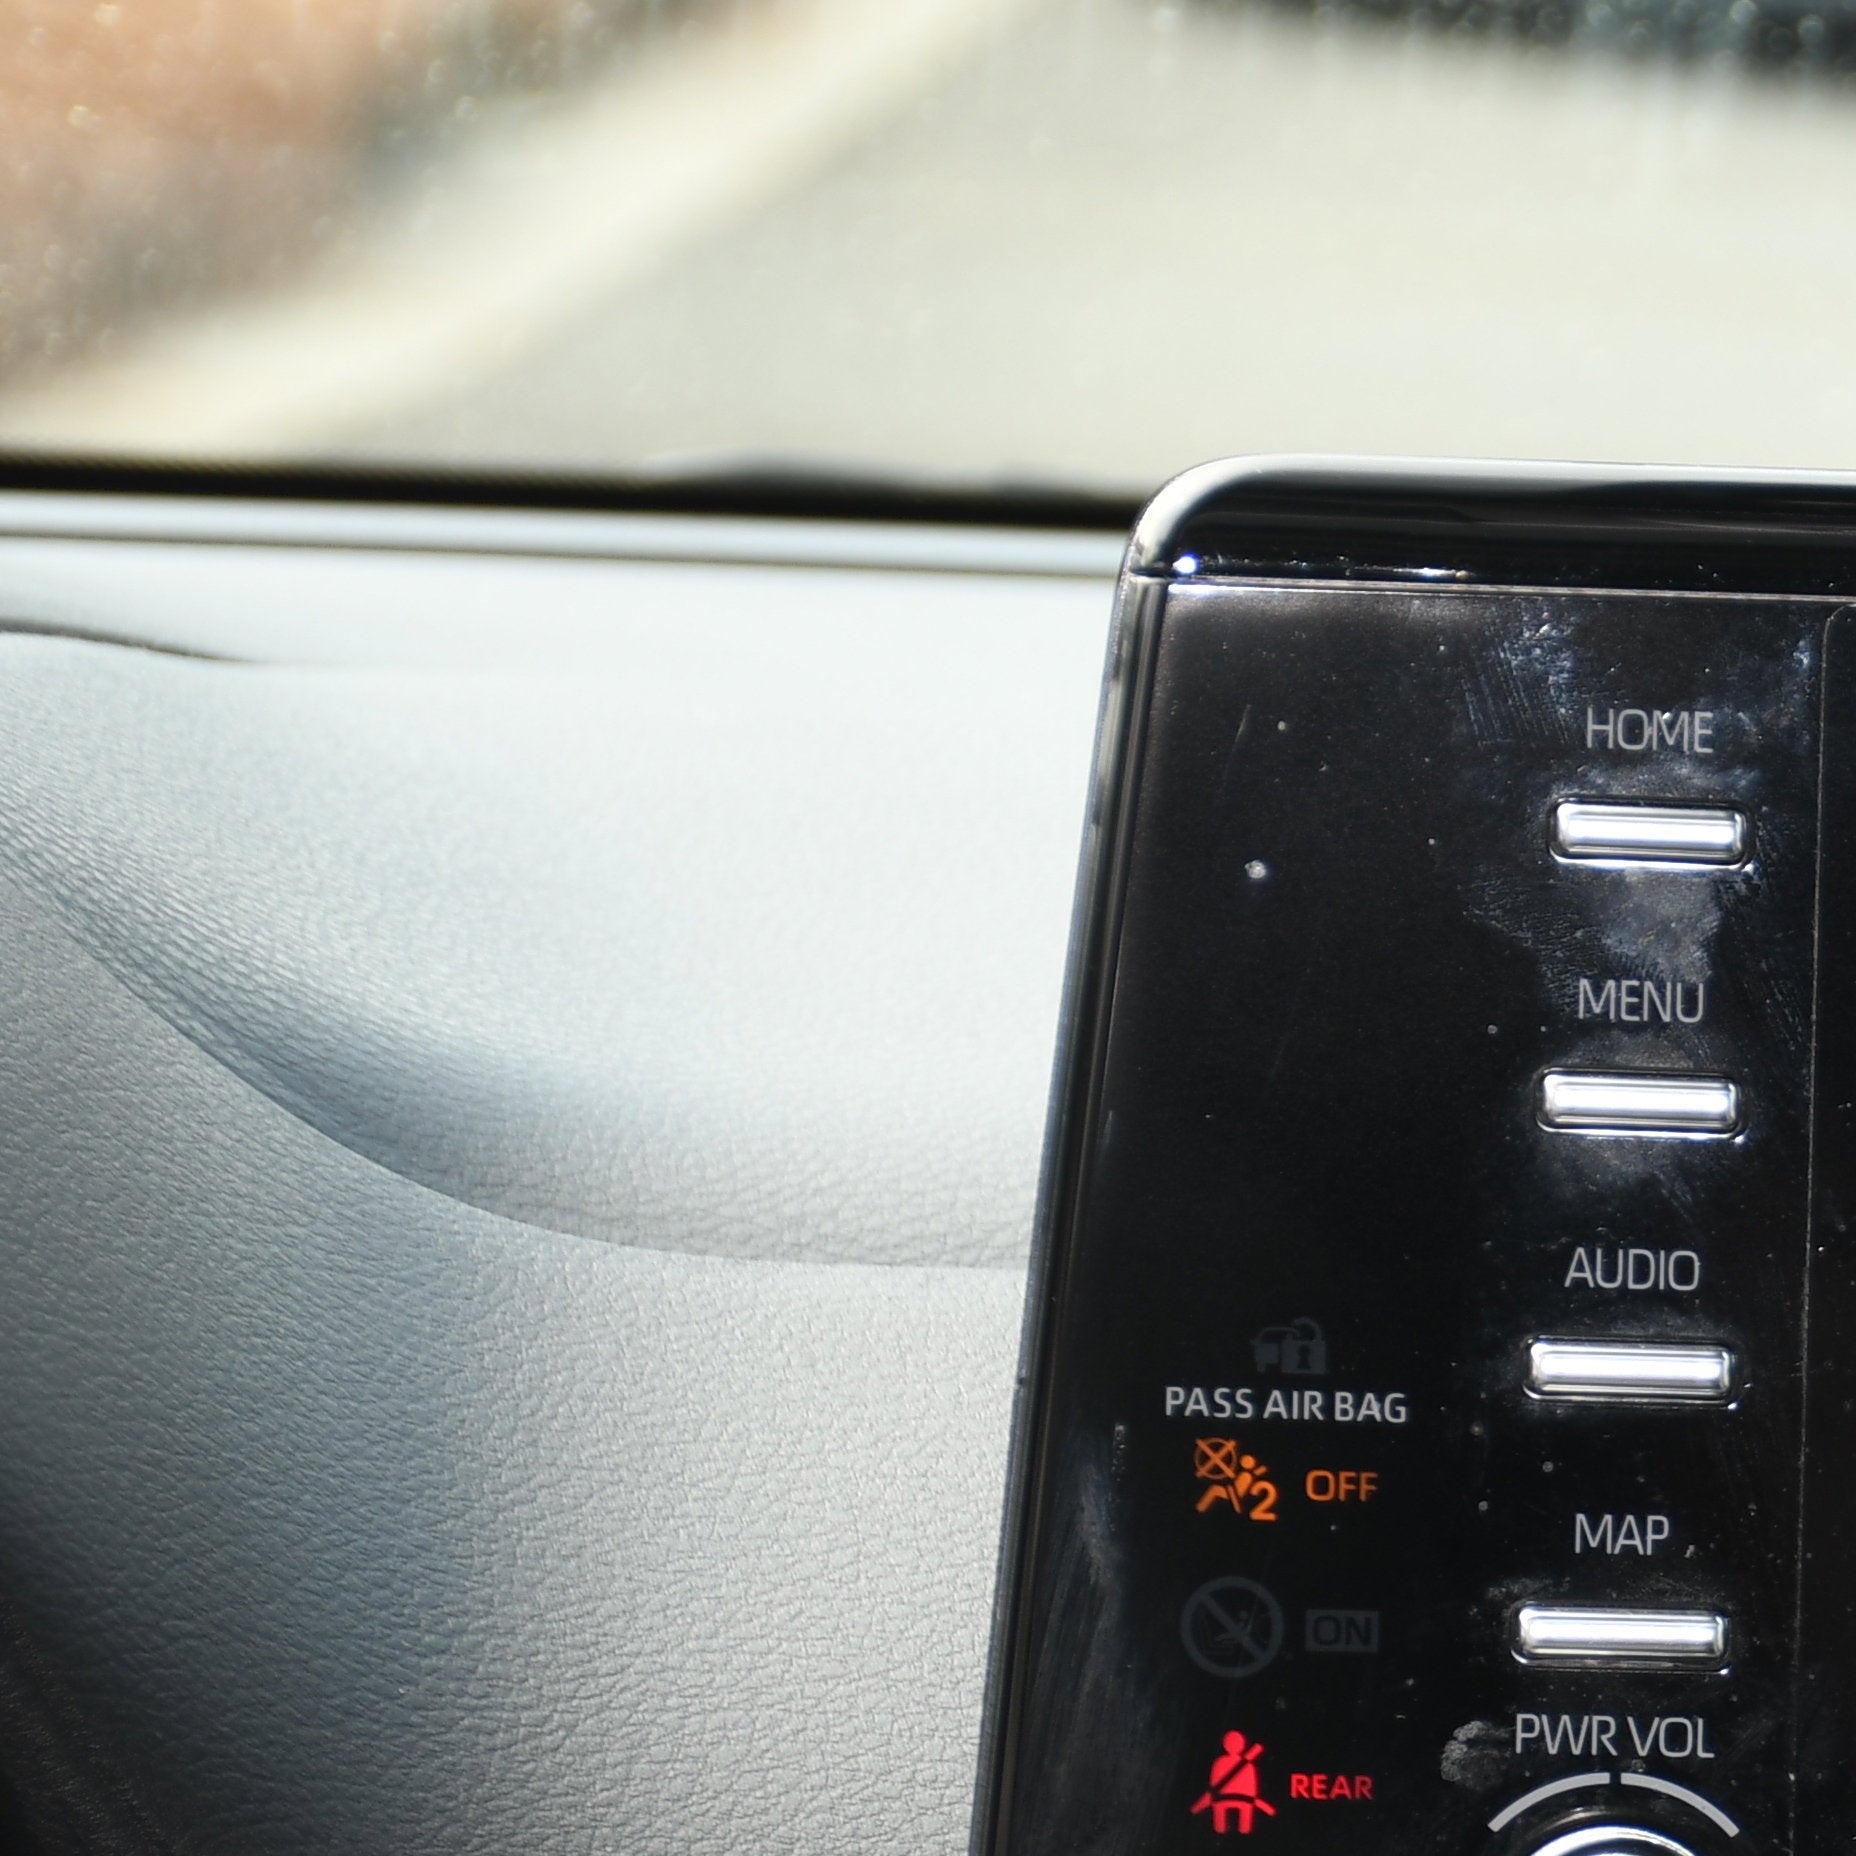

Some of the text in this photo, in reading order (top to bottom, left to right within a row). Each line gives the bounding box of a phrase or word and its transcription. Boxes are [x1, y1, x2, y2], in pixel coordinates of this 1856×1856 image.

[1587, 708, 1714, 755] HOME
[1577, 977, 1706, 1023] MENU
[1565, 1247, 1700, 1290] AUDIO
[1166, 1387, 1406, 1423] PASS AIR BAG
[1306, 1470, 1376, 1501] OFF
[1575, 1514, 1669, 1555] MAP
[1516, 1714, 1714, 1758] PWR VOL
[1291, 1774, 1371, 1799] REAR
